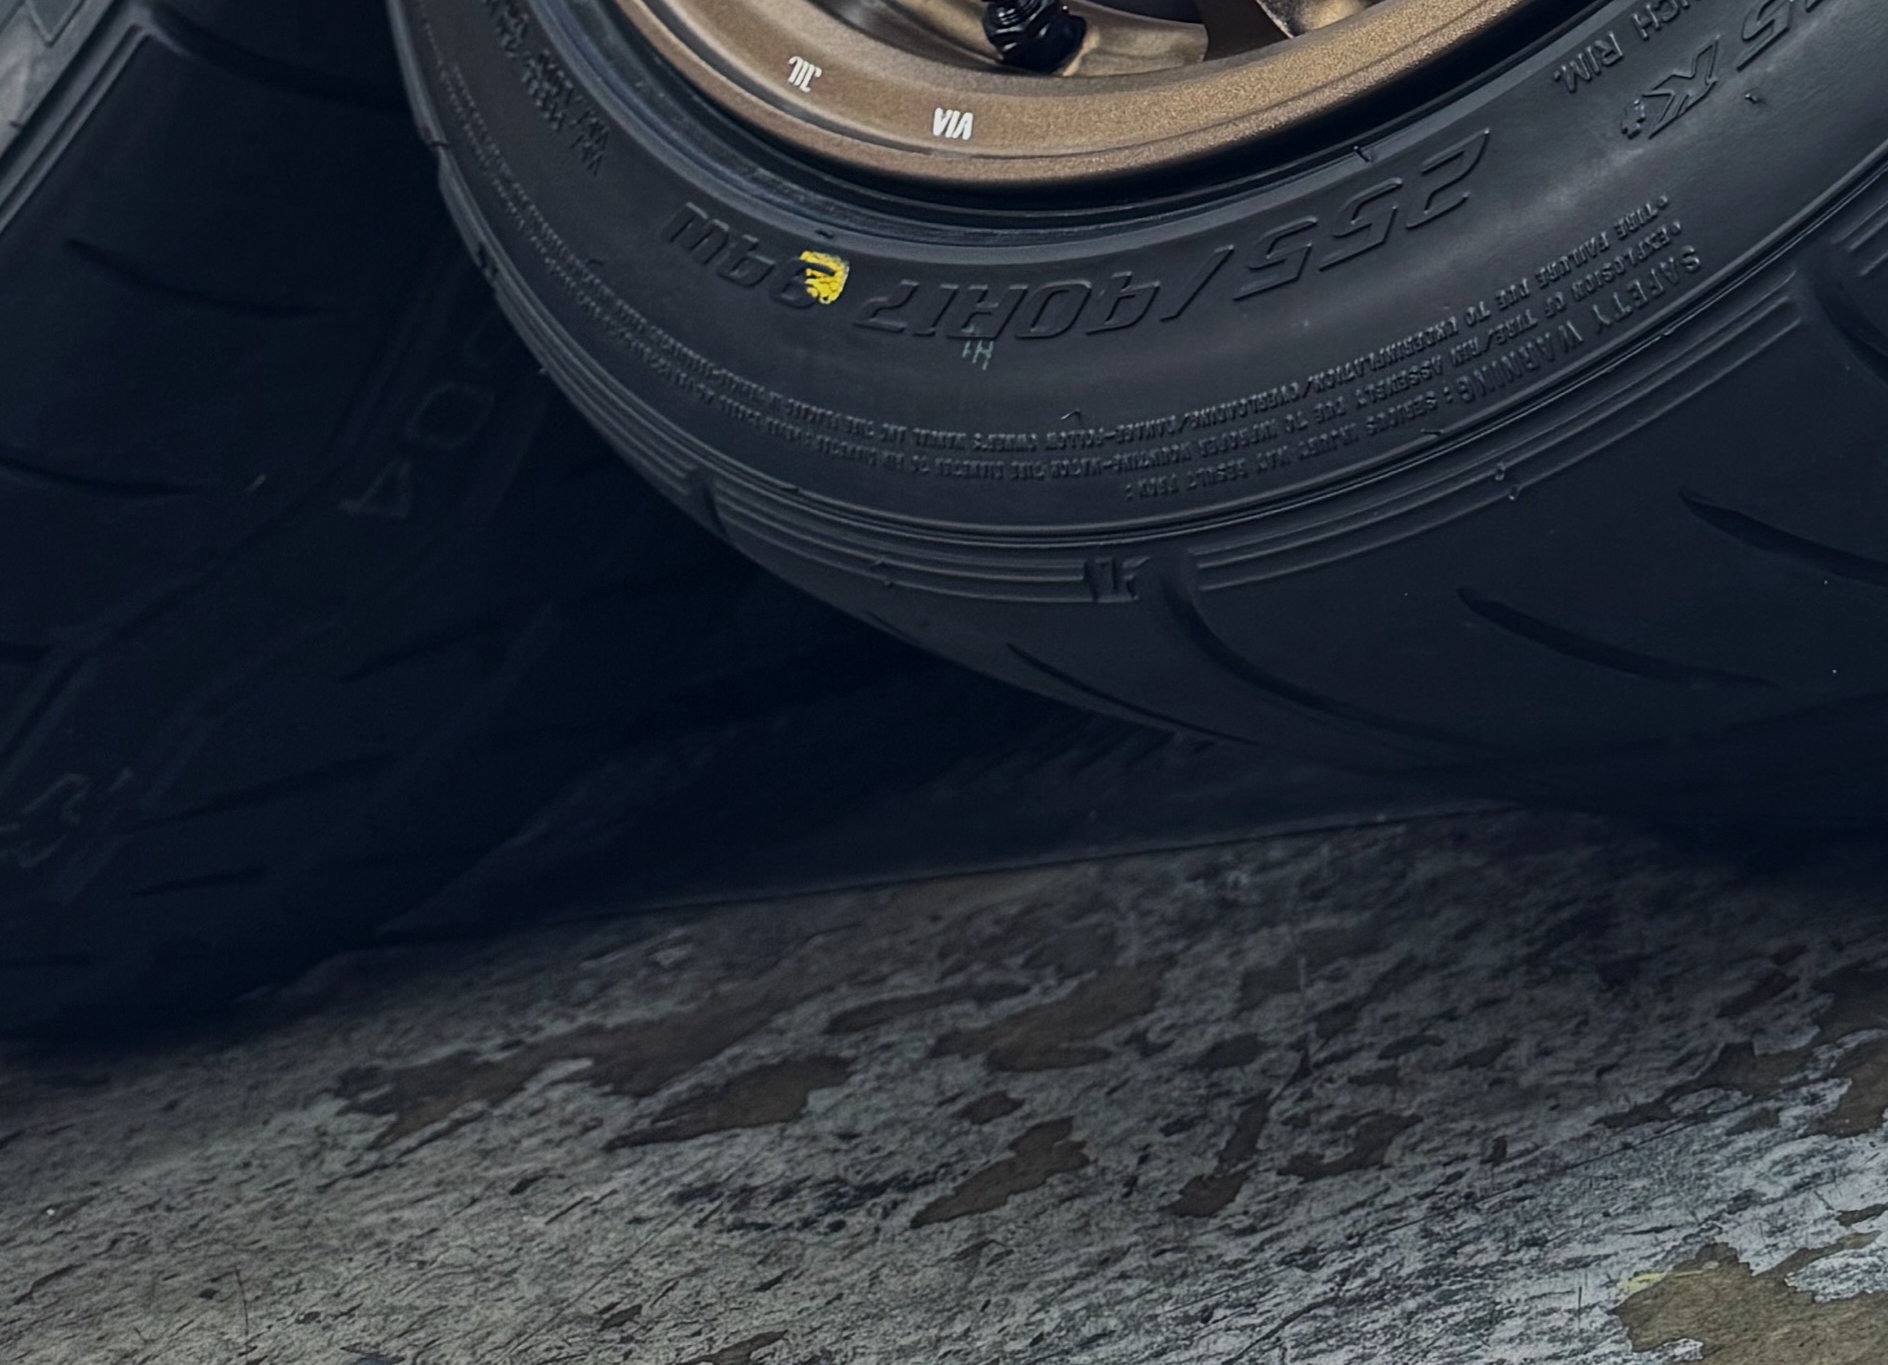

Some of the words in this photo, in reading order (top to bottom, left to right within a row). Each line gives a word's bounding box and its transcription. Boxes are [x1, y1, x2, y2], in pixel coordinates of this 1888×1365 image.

[932, 107, 974, 140] VIA
[852, 127, 1490, 342] 255/40R17
[1594, 245, 1701, 334] SAFETY
